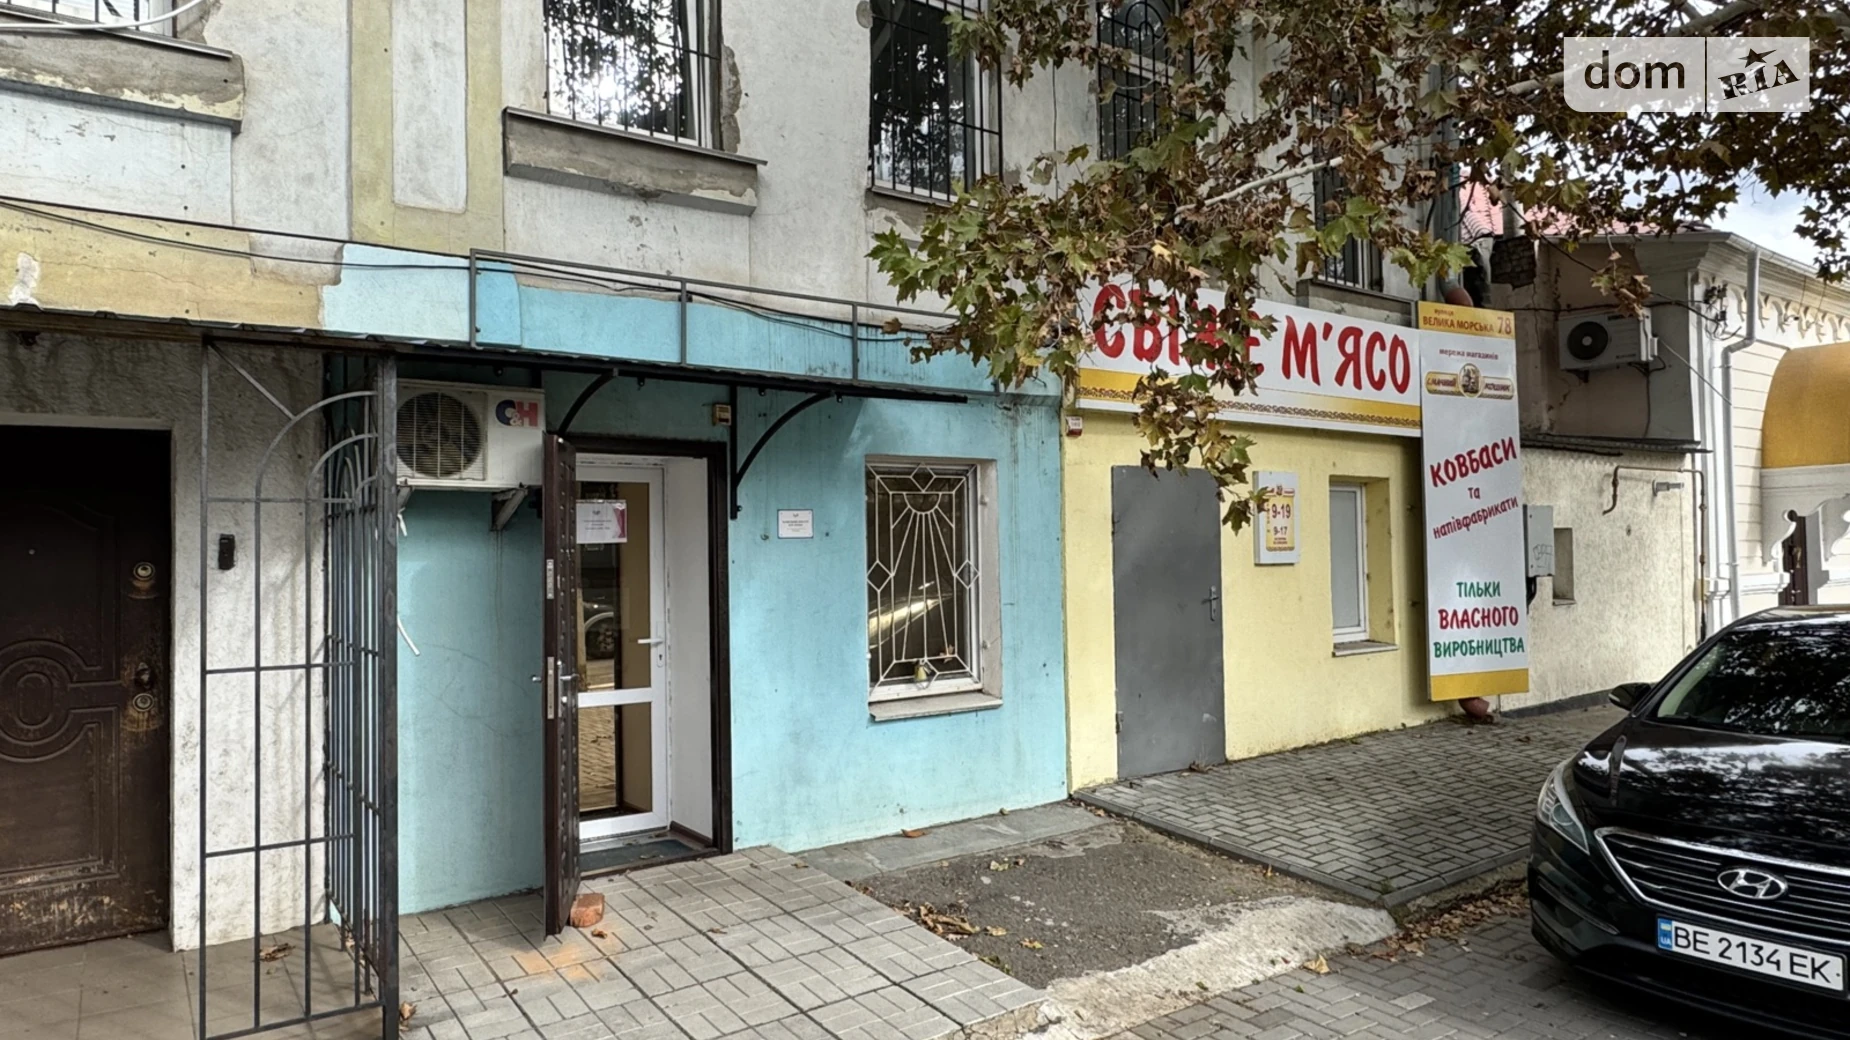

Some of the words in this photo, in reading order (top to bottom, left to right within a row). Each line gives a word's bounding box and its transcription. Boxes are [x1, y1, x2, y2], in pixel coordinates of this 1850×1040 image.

[1422, 315, 1455, 329] ВЕЛИКА
[1456, 319, 1494, 333] МОРСЬКА
[1497, 316, 1512, 335] 78
[1092, 283, 1265, 376] СВІЕ
[1281, 315, 1411, 394] М'ЯСО
[495, 399, 538, 427] C&H
[1467, 487, 1481, 499] та
[1271, 503, 1291, 519] 9-19
[1432, 496, 1519, 540] напівфабрикати
[1273, 526, 1288, 536] 9-17
[1456, 581, 1501, 598] ТІЛЬКИ
[1438, 605, 1519, 630] ВЛАСНОГО
[1433, 637, 1525, 659] ВИРОБНИЦТВА
[1660, 936, 1672, 946] UA
[1674, 926, 1711, 955] BE
[1718, 937, 1781, 972] 2134
[1789, 952, 1832, 984] EK
